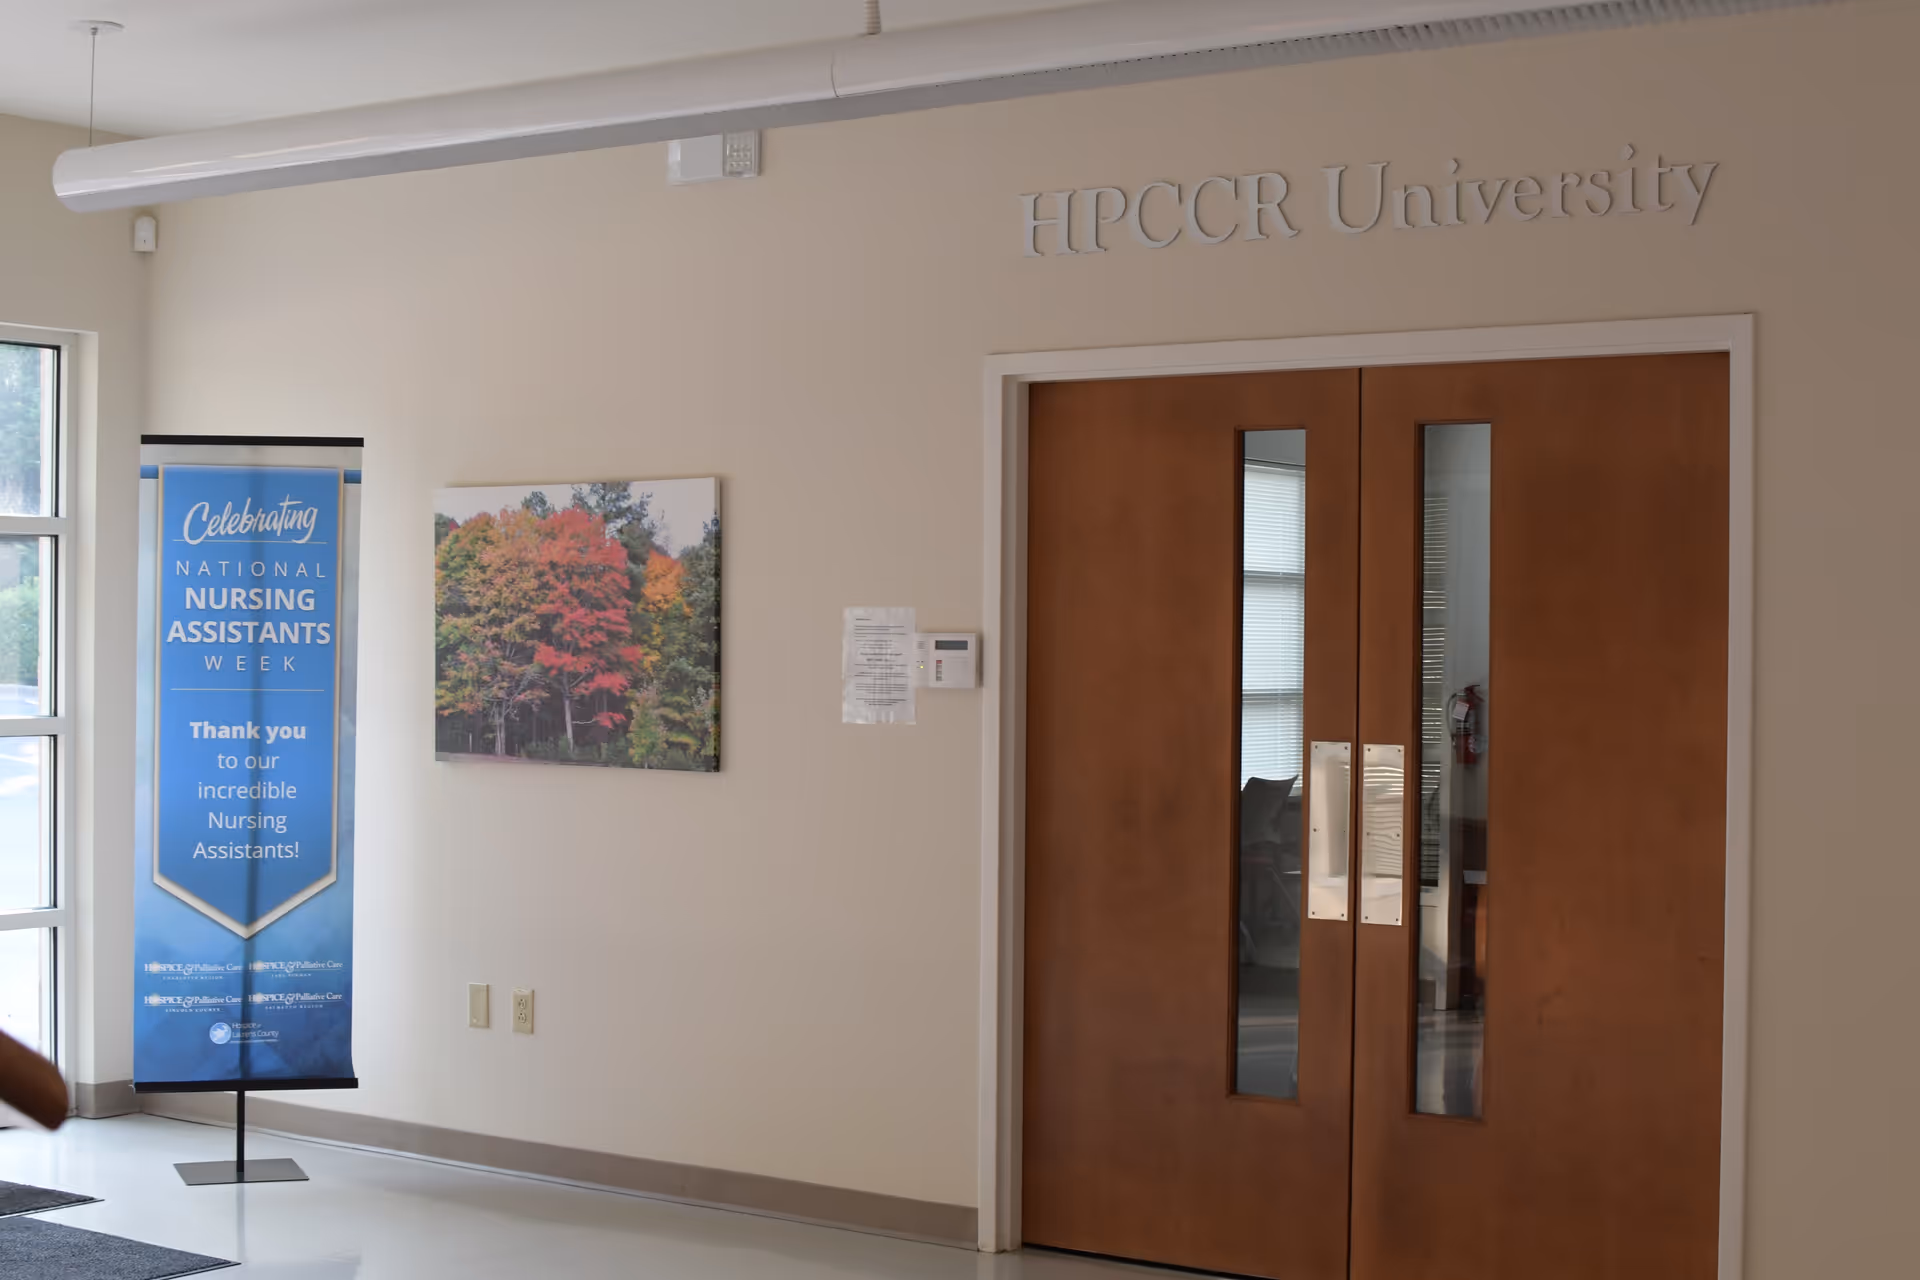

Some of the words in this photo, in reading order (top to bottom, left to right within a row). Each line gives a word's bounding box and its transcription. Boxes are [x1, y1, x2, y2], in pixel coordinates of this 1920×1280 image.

[1018, 171, 1301, 259] HPCCR
[1320, 142, 1720, 236] University
[182, 493, 319, 546] Celebrating
[176, 560, 327, 578] NATIONAL
[185, 587, 316, 611] NURSING
[166, 620, 331, 645] ASSISTANTS
[204, 655, 296, 672] WEEK
[189, 720, 260, 740] Thank
[265, 725, 306, 745] you
[217, 753, 238, 769] to
[244, 755, 280, 769] our
[198, 781, 297, 799] incredible
[208, 811, 288, 834] Nursing
[192, 841, 300, 859] Assistants!
[326, 960, 343, 969] Care
[326, 992, 343, 1000] Care
[257, 1029, 279, 1039] County
